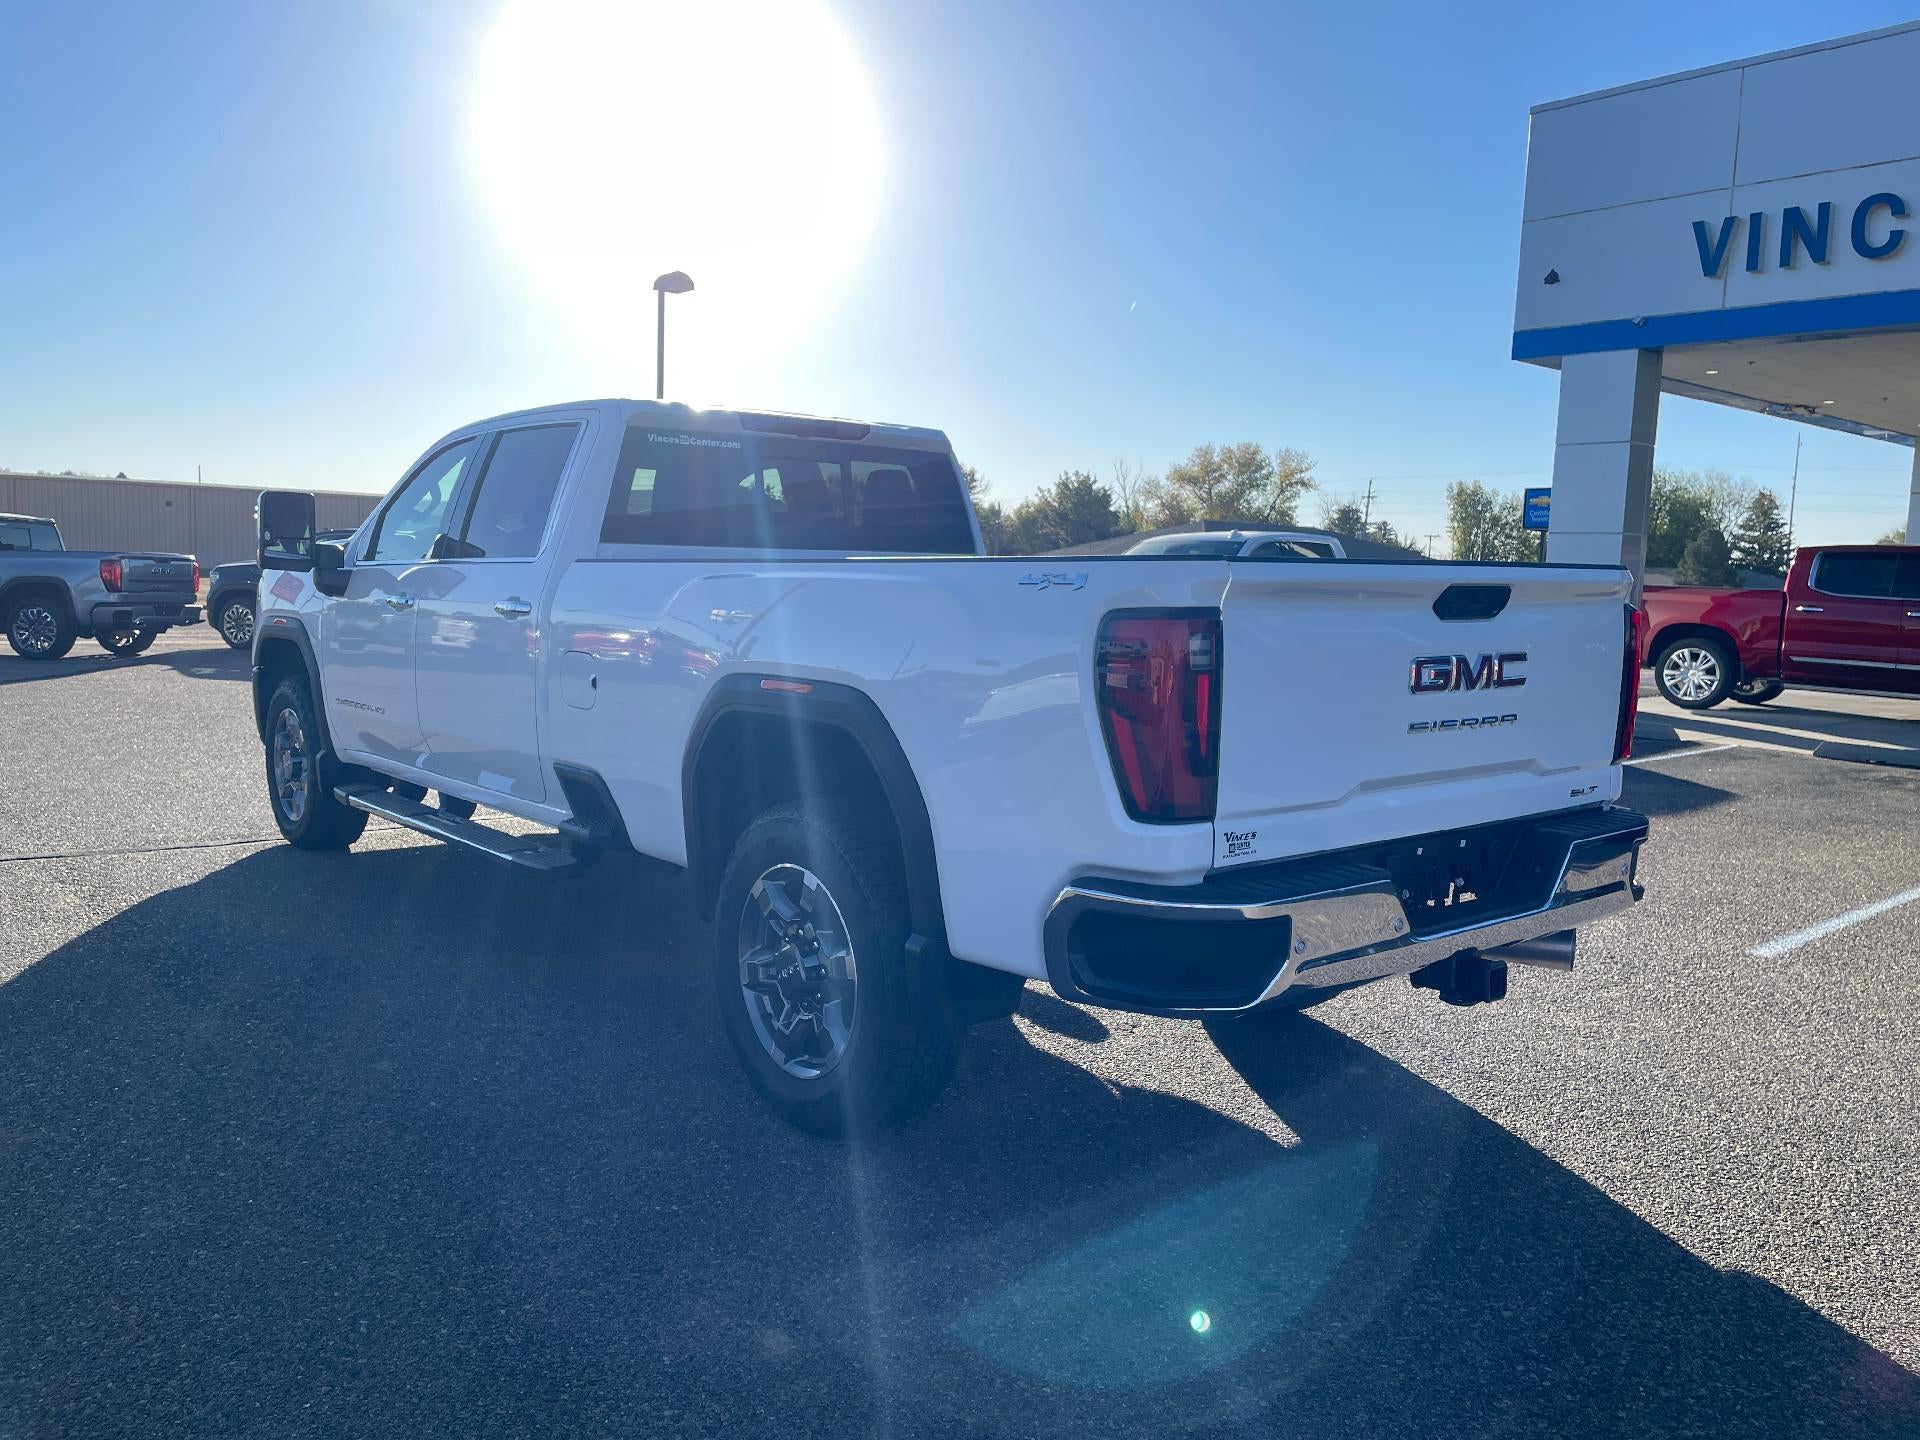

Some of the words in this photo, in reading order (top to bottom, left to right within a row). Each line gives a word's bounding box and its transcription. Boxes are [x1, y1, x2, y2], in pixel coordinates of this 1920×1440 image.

[1692, 192, 1911, 280] VINC
[1407, 650, 1529, 695] GMC
[1406, 712, 1519, 735] SIERRA
[1569, 785, 1600, 798] SLT
